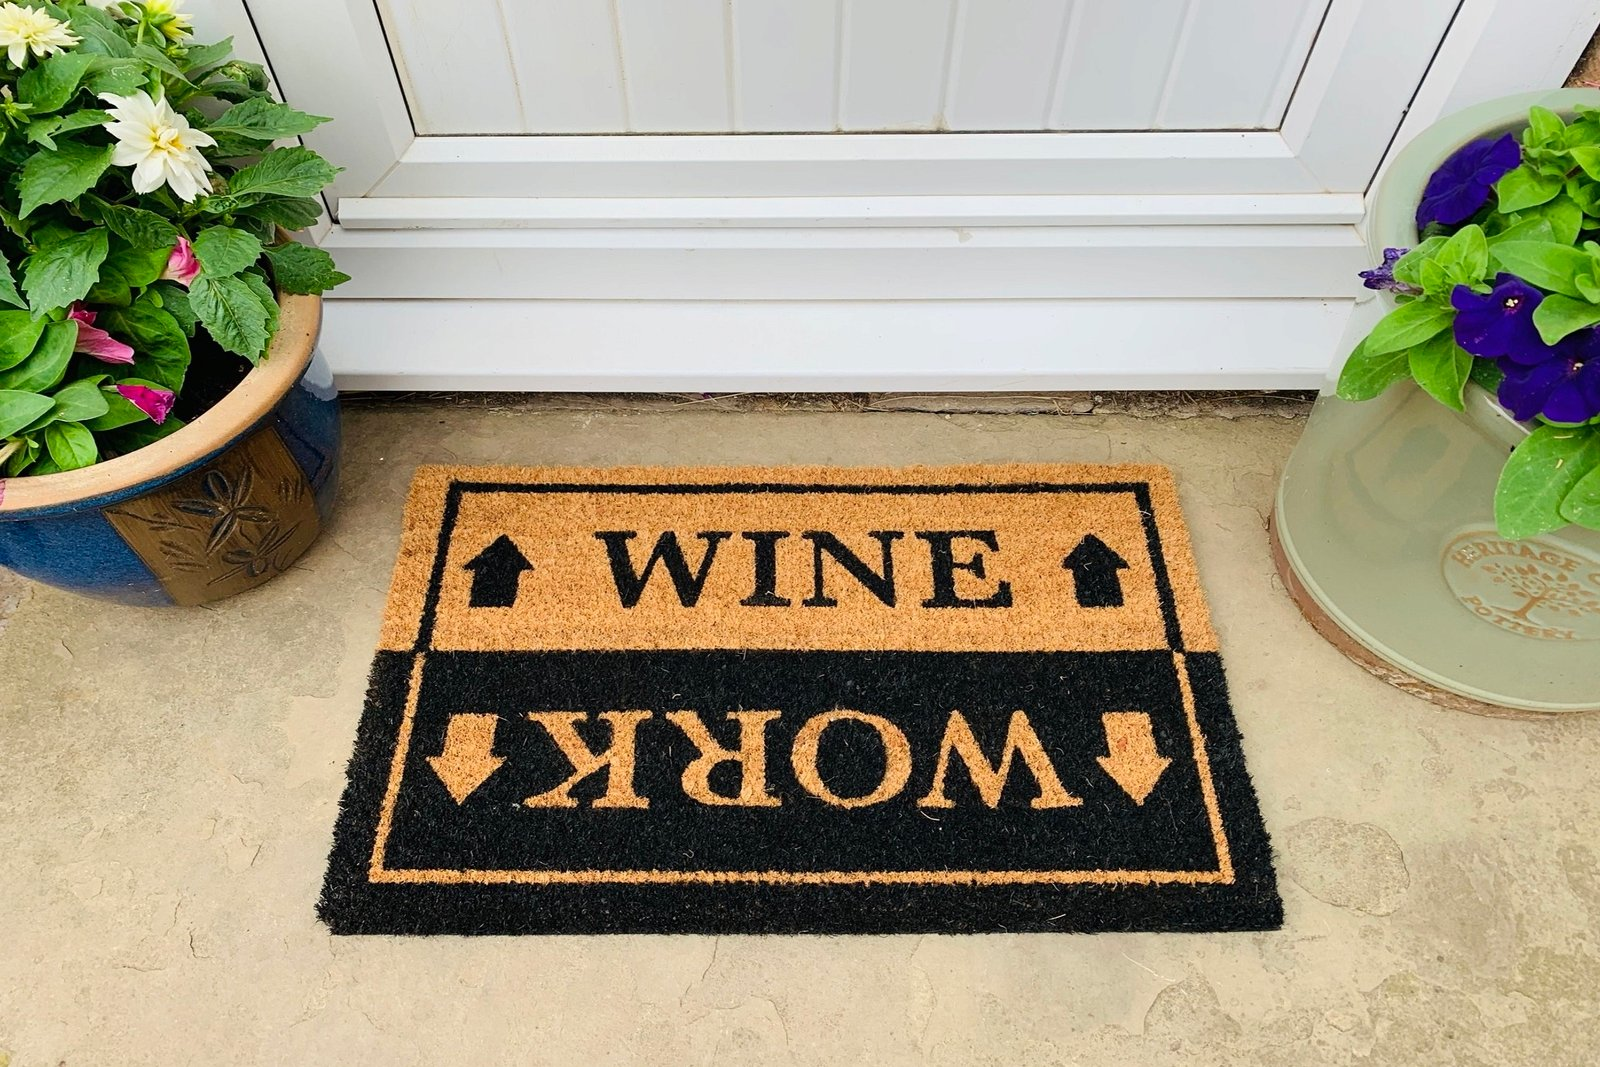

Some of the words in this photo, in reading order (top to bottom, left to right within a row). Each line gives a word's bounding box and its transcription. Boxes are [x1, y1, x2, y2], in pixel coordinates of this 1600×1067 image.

[595, 530, 1012, 610] WINE
[1451, 541, 1582, 573] HERITAGE
[1460, 595, 1577, 640] POTTERY
[523, 709, 1083, 811] WORK
